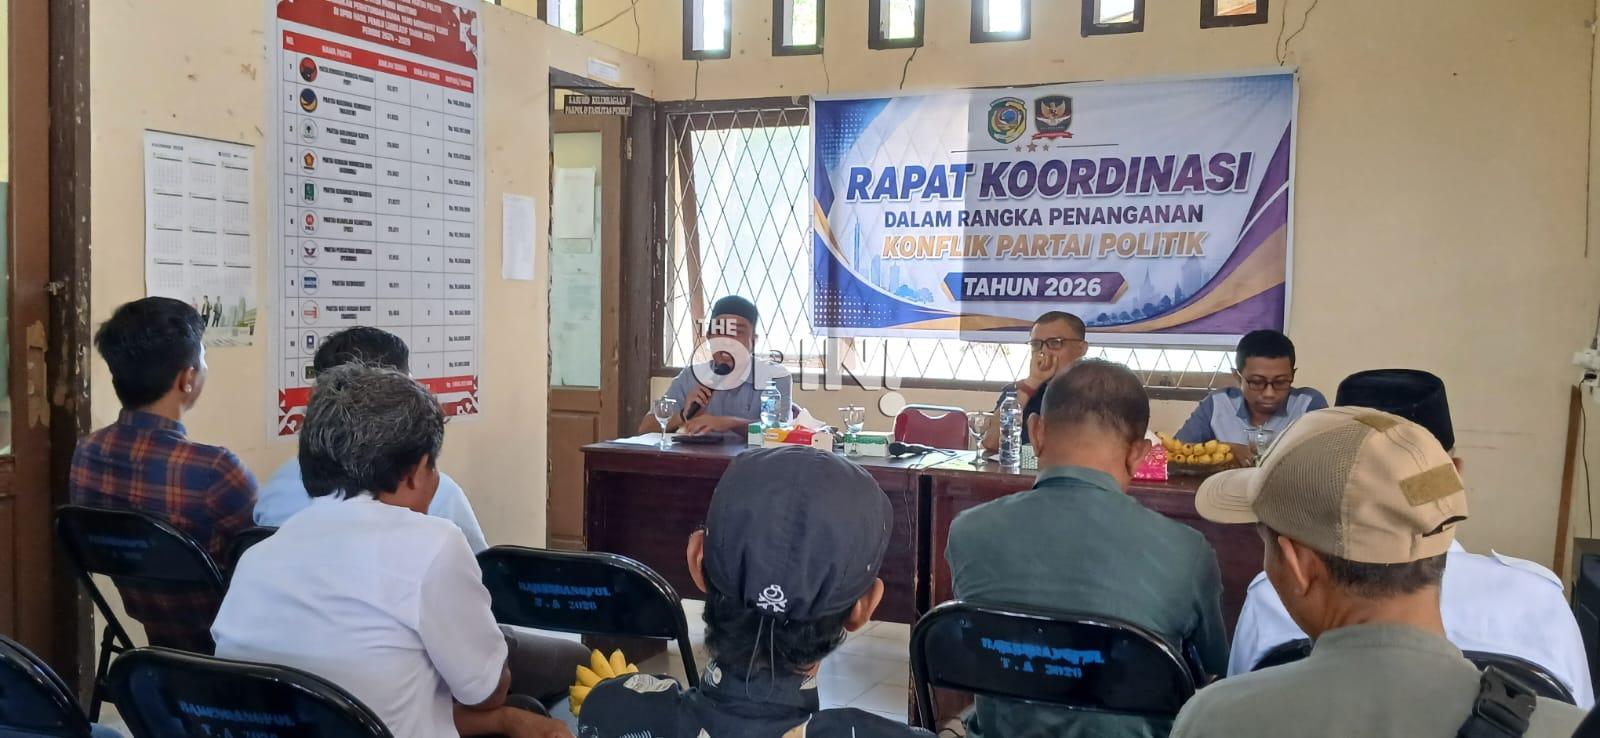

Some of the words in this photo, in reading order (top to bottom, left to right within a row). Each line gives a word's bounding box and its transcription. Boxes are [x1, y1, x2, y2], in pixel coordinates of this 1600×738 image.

[846, 161, 975, 203] RAPAT
[978, 150, 1252, 200] KOORDINASI
[884, 208, 953, 229] DALAM
[957, 208, 1043, 228] RANGKA
[1048, 204, 1204, 226] PENANGANAN
[882, 232, 991, 259] KONFLIK
[995, 232, 1091, 258] PARTAI
[1096, 230, 1208, 257] POLITIK
[963, 276, 1041, 297] TAHUN
[1044, 277, 1102, 297] 2026
